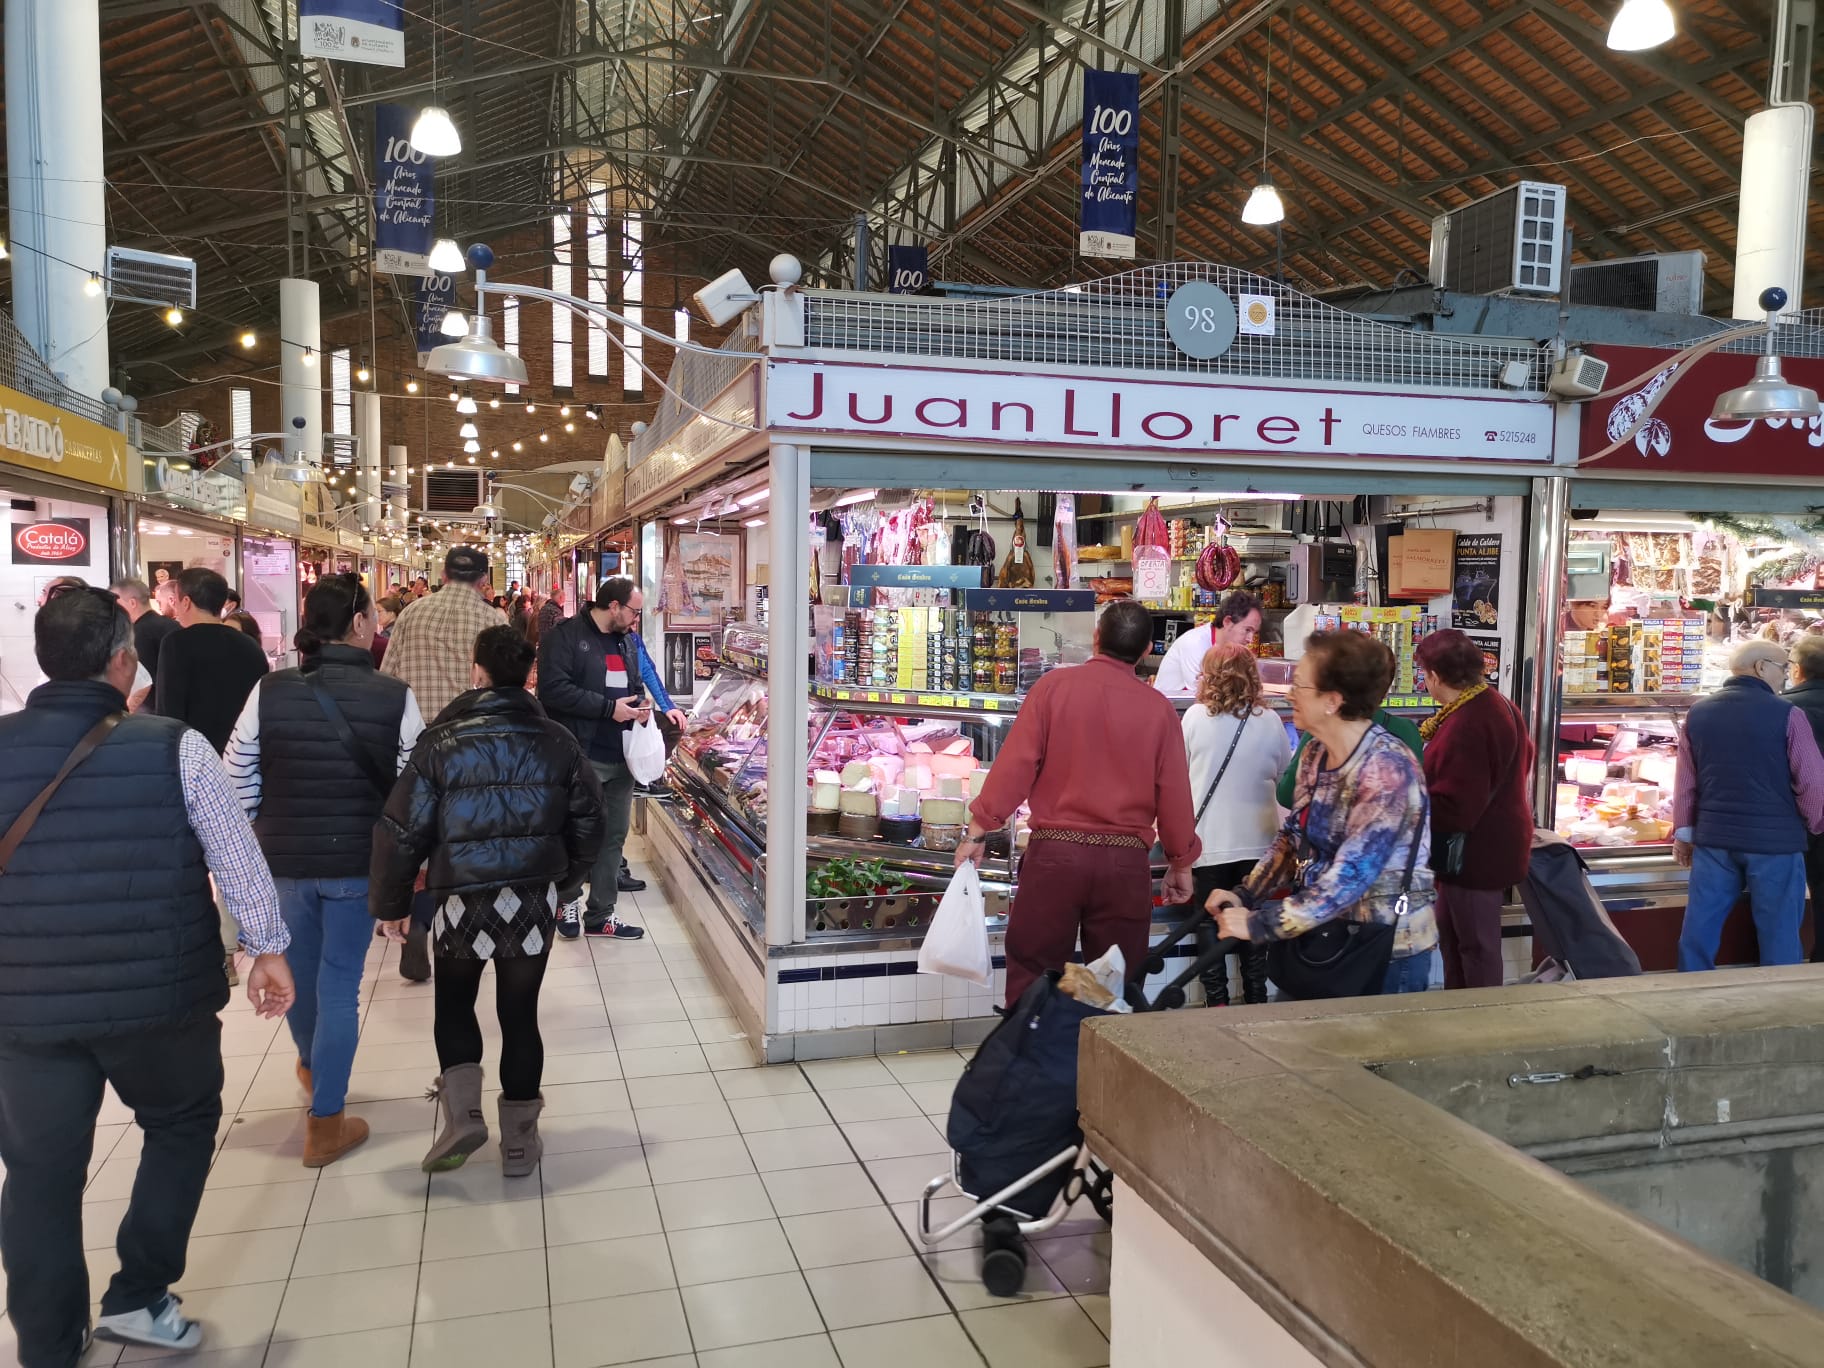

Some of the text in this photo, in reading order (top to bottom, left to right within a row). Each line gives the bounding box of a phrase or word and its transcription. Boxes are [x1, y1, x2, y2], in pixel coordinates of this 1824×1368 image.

[1090, 104, 1132, 135] 100
[384, 136, 427, 165] 100
[1098, 137, 1122, 153] Años
[1089, 153, 1126, 170] Mercado
[393, 165, 417, 180] Años
[1090, 170, 1125, 186] Central
[384, 179, 422, 196] Mercado
[1085, 187, 1134, 205] de Alicante
[386, 195, 422, 209] Central
[380, 210, 432, 228] de Alicante
[420, 275, 451, 292] 100
[893, 268, 923, 288] 100
[1184, 305, 1216, 333] 98
[786, 372, 1342, 445] Juan Lloret
[1362, 423, 1461, 440] QUESOS FIAMBRES
[1499, 431, 1537, 444] 5215248
[25, 530, 78, 545] Catalá
[1472, 538, 1479, 546] de
[1480, 537, 1500, 546] Caldero
[1144, 571, 1156, 588] 8
